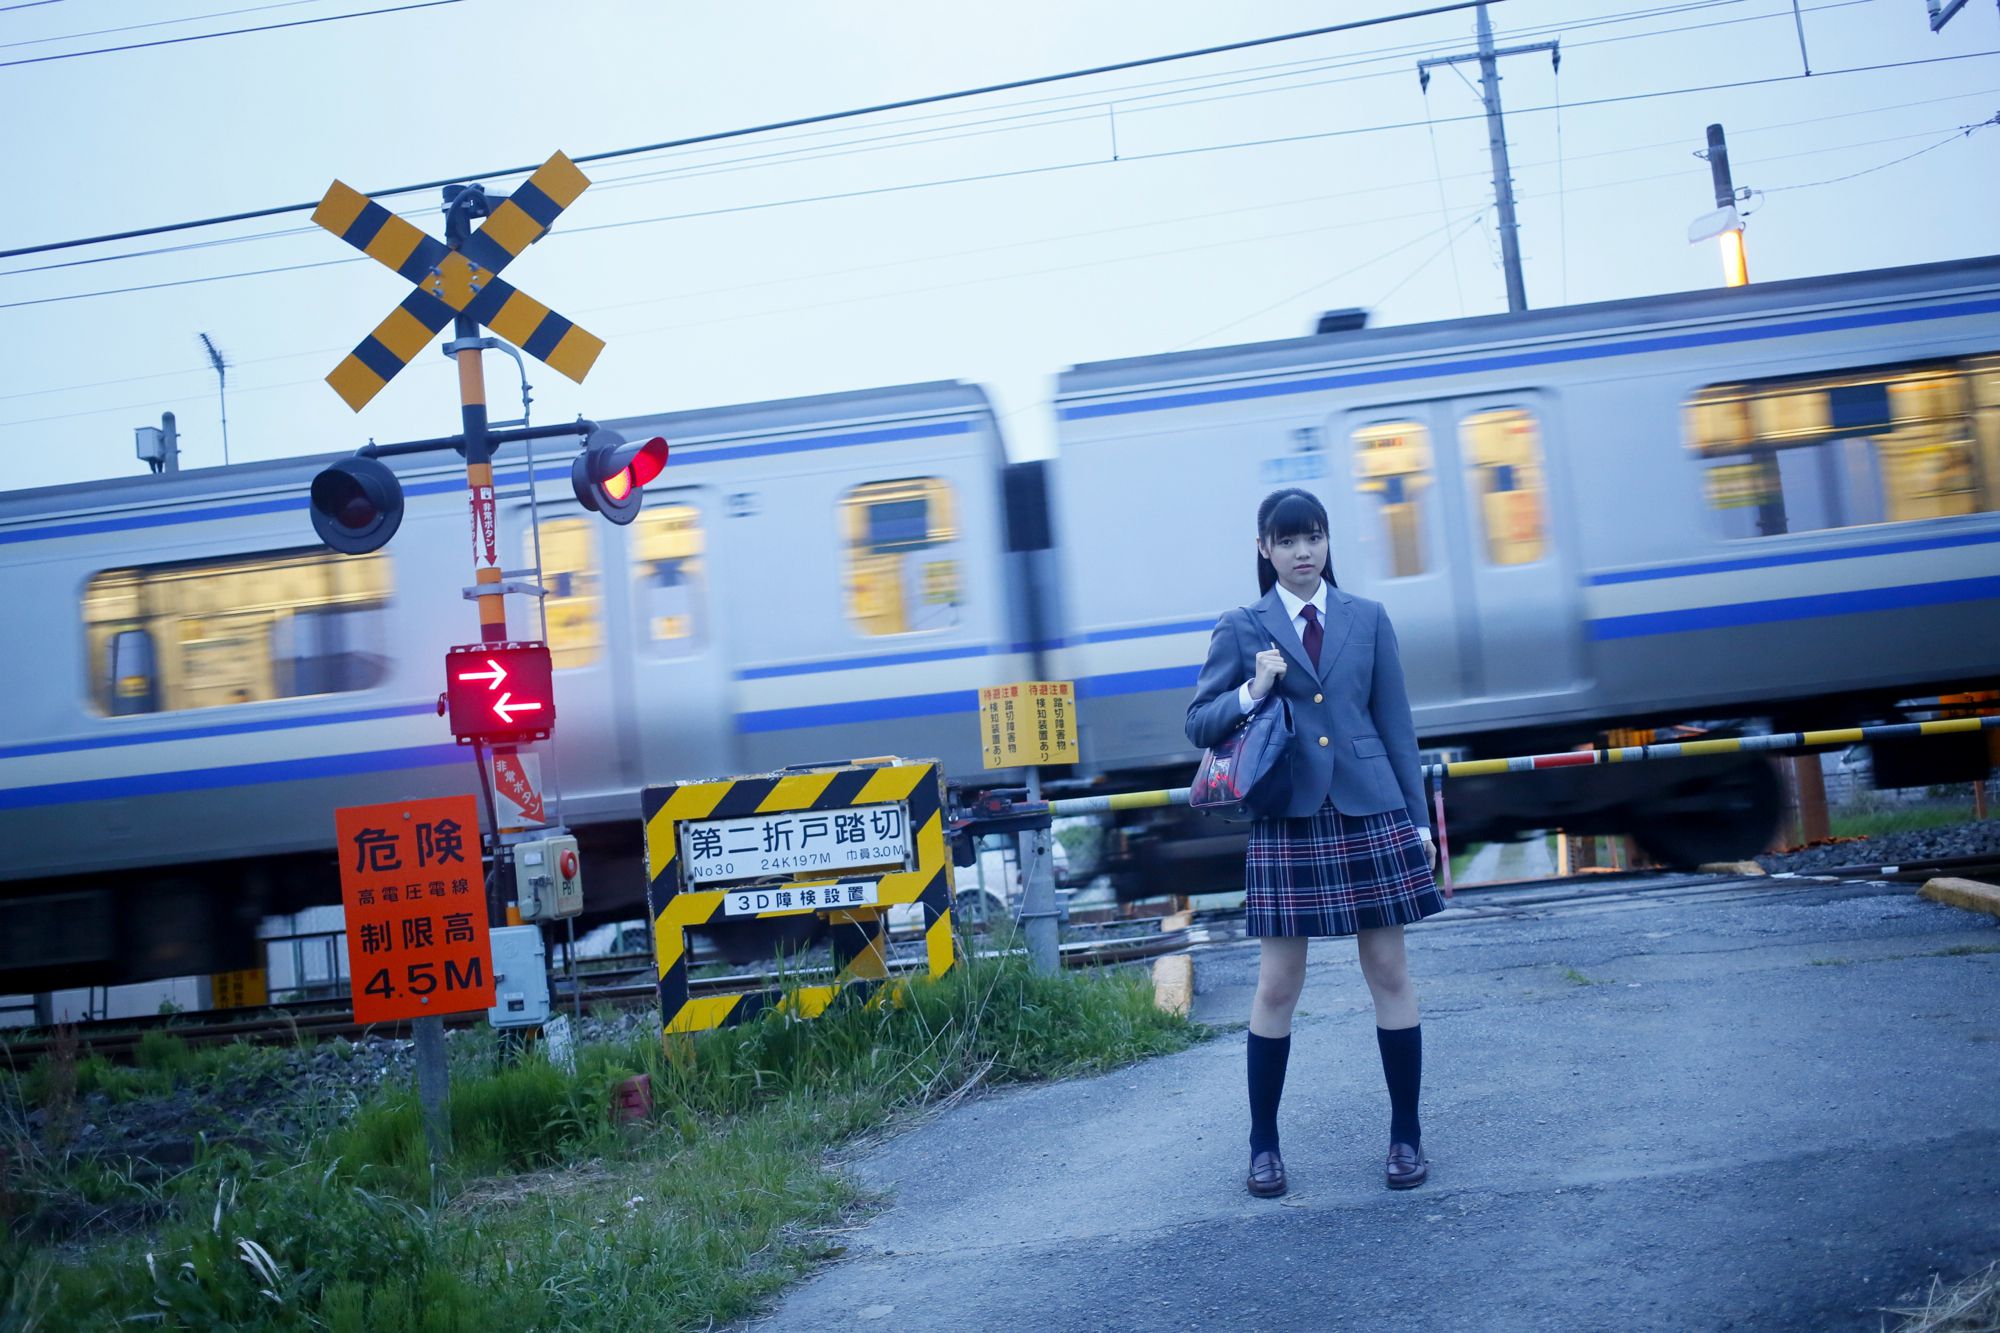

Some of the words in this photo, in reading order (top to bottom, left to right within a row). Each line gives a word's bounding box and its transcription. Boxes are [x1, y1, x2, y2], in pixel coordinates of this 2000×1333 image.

[483, 502, 494, 547] 非常ボタン
[984, 686, 1019, 700] 待避注意
[1029, 684, 1068, 696] 待避注意
[990, 702, 1002, 766] 検知装置あり
[1005, 700, 1017, 754] 踏切障害物
[1036, 698, 1049, 762] 検知装置あり
[1053, 697, 1066, 751] 踏切障害物
[496, 760, 540, 815] 非常ボタン
[353, 818, 465, 874] 危険
[690, 809, 902, 861] 第二折戸踏切
[694, 862, 735, 877] No30
[760, 852, 832, 870] 24K197M
[357, 878, 469, 906] 高電圧電線
[562, 881, 575, 896] PB1
[737, 885, 867, 911] 3D障検設置
[360, 912, 474, 956] 制限高
[364, 956, 483, 1000] 4.5M
